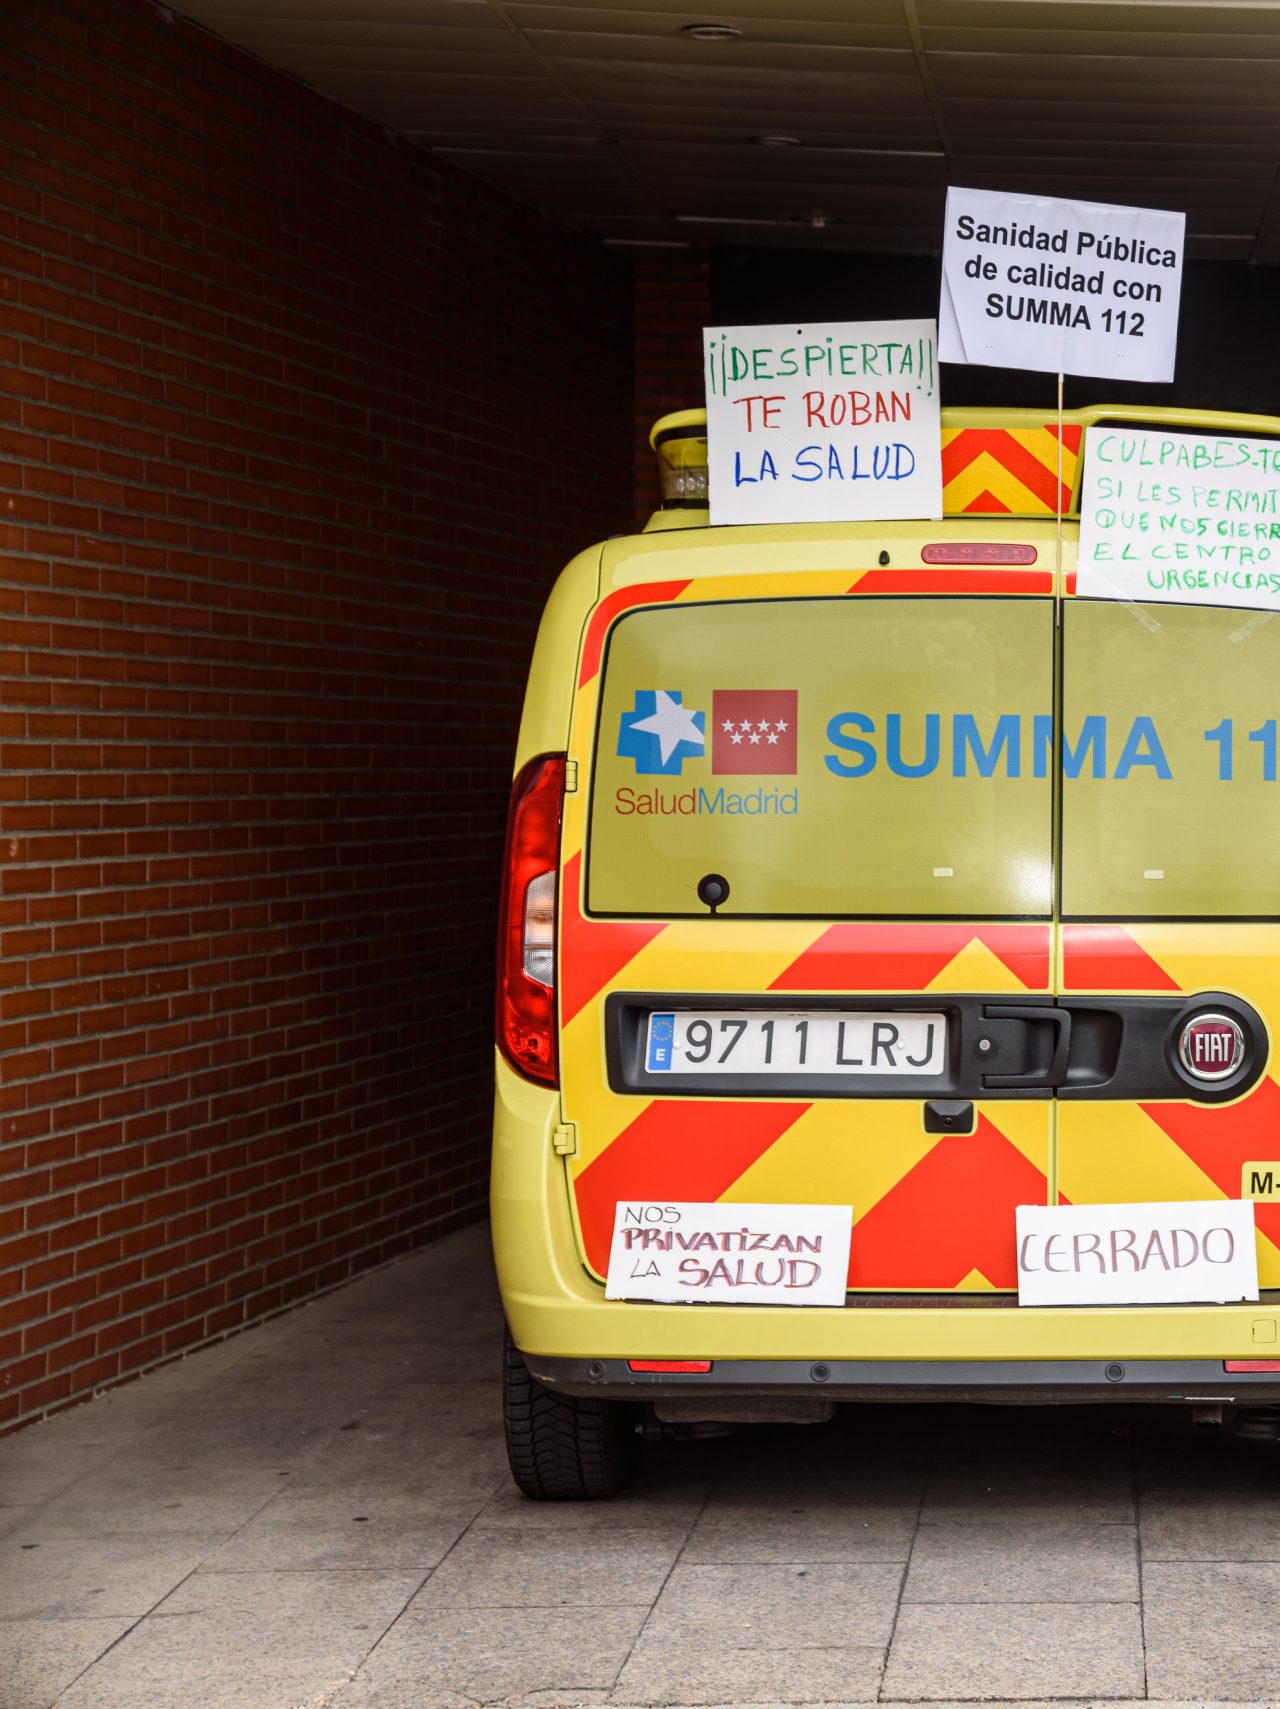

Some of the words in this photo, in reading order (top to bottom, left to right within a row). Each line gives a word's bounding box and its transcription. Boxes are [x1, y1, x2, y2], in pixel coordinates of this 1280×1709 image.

[956, 215, 1068, 254] Sanidad
[1077, 232, 1177, 268] Pública
[964, 254, 998, 280] de
[1007, 263, 1104, 295] calidad
[1113, 278, 1162, 303] con
[985, 293, 1091, 330] SUMMA
[1101, 308, 1145, 337] 112
[732, 395, 786, 432] TE
[802, 391, 911, 428] ROBAN
[735, 450, 780, 487] LA
[792, 443, 915, 481] SALUD
[1097, 477, 1122, 499] SI
[1137, 480, 1181, 506] LES
[1095, 508, 1149, 532] QUE
[1160, 513, 1212, 537] NOS
[1093, 543, 1140, 560] EL
[1151, 543, 1271, 566] CENTRO
[824, 711, 1172, 781] SUMMA
[615, 787, 798, 815] SaludMadrid
[655, 1048, 665, 1062] E
[684, 1019, 809, 1065] 9711
[836, 1021, 935, 1067] LRJ
[1195, 1033, 1232, 1062] FIAT
[624, 1206, 682, 1224] NOS
[620, 1227, 822, 1253] PRIVATIZAN
[1020, 1228, 1235, 1274] CERRADO
[630, 1259, 661, 1278] LA
[678, 1258, 821, 1288] SALUD
